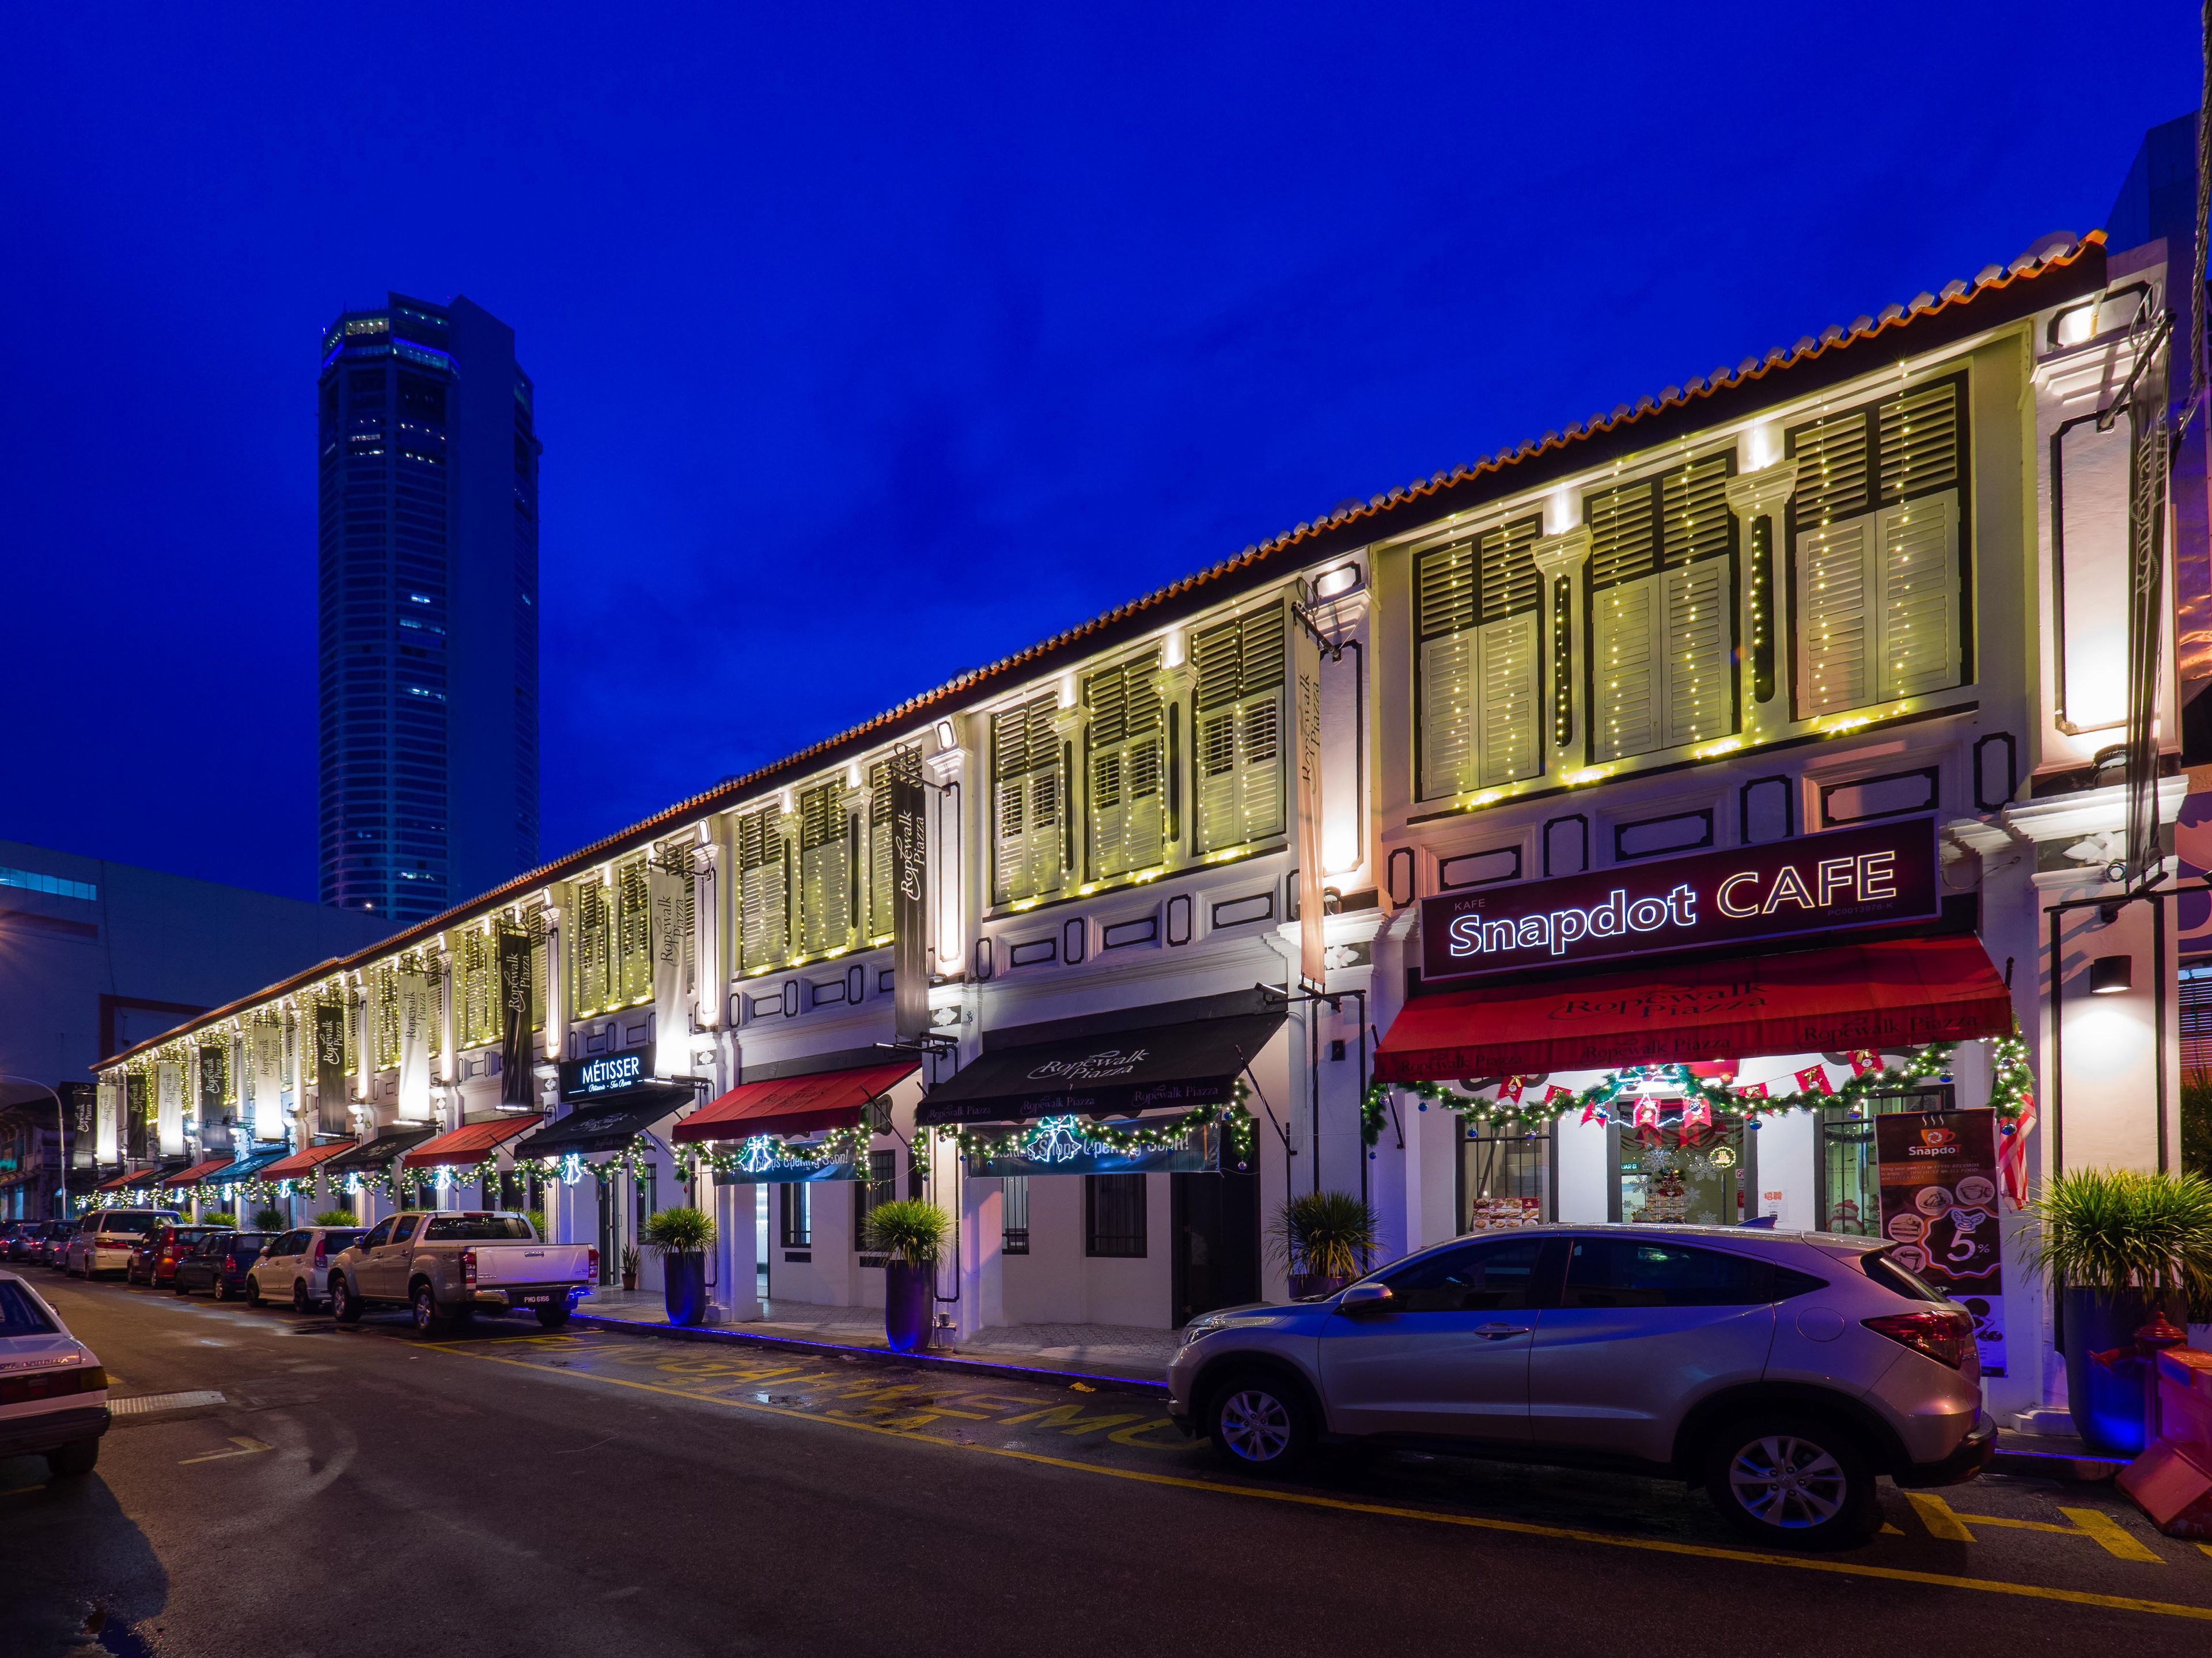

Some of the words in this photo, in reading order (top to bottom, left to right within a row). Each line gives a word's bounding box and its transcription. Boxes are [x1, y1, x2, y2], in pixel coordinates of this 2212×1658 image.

[1310, 682, 1320, 749] Piazza
[1299, 671, 1316, 794] Ropewalk
[896, 809, 921, 900] Ropewalk
[914, 817, 925, 865] Piazza
[674, 899, 684, 938] Piazza
[1450, 884, 1696, 956] Snapdot
[1717, 850, 1896, 918] CAFE
[1455, 898, 1486, 911] KAFE
[656, 896, 680, 967] Ropewalk
[505, 953, 526, 1012] Ropewalk
[520, 955, 531, 989] Piazza
[402, 991, 422, 1041] Ropewalk
[417, 993, 426, 1021] Piazza
[1550, 981, 1770, 1020] Ropewalk
[1641, 997, 1766, 1018] Piazza
[320, 1020, 338, 1064] Ropewalk
[334, 1022, 343, 1047] Piazza
[1797, 1016, 1899, 1048] Ropewalk
[1910, 1015, 1977, 1031] Piazza
[259, 1038, 275, 1077] Ropewalk
[269, 1039, 278, 1062] Piazza
[1027, 1049, 1150, 1079] Ropewalk
[1396, 1050, 1469, 1077] Ropewalk
[1476, 1054, 1522, 1067] Piazza
[1580, 1038, 1666, 1065] Ropewalk
[1675, 1038, 1730, 1052] Piazza
[202, 1058, 220, 1093] Ropewalk
[214, 1058, 222, 1080] Piazza
[582, 1057, 639, 1084] MÉTISSER
[1066, 1065, 1134, 1079] Piazza
[128, 1083, 143, 1113] Ropewalk
[162, 1072, 178, 1105] Ropewalk
[1131, 1085, 1181, 1107] Ropewalk
[1186, 1086, 1218, 1097] Piazza
[75, 1104, 89, 1132] Ropewalk
[927, 1105, 964, 1122] Ropewalk
[967, 1106, 991, 1116] Piazza
[1020, 1096, 1063, 1115] Ropewalk
[1067, 1097, 1094, 1107] Piazza
[1764, 1191, 1783, 1201] 招聘
[1947, 1228, 1976, 1262] 5
[1978, 1243, 1990, 1254] %
